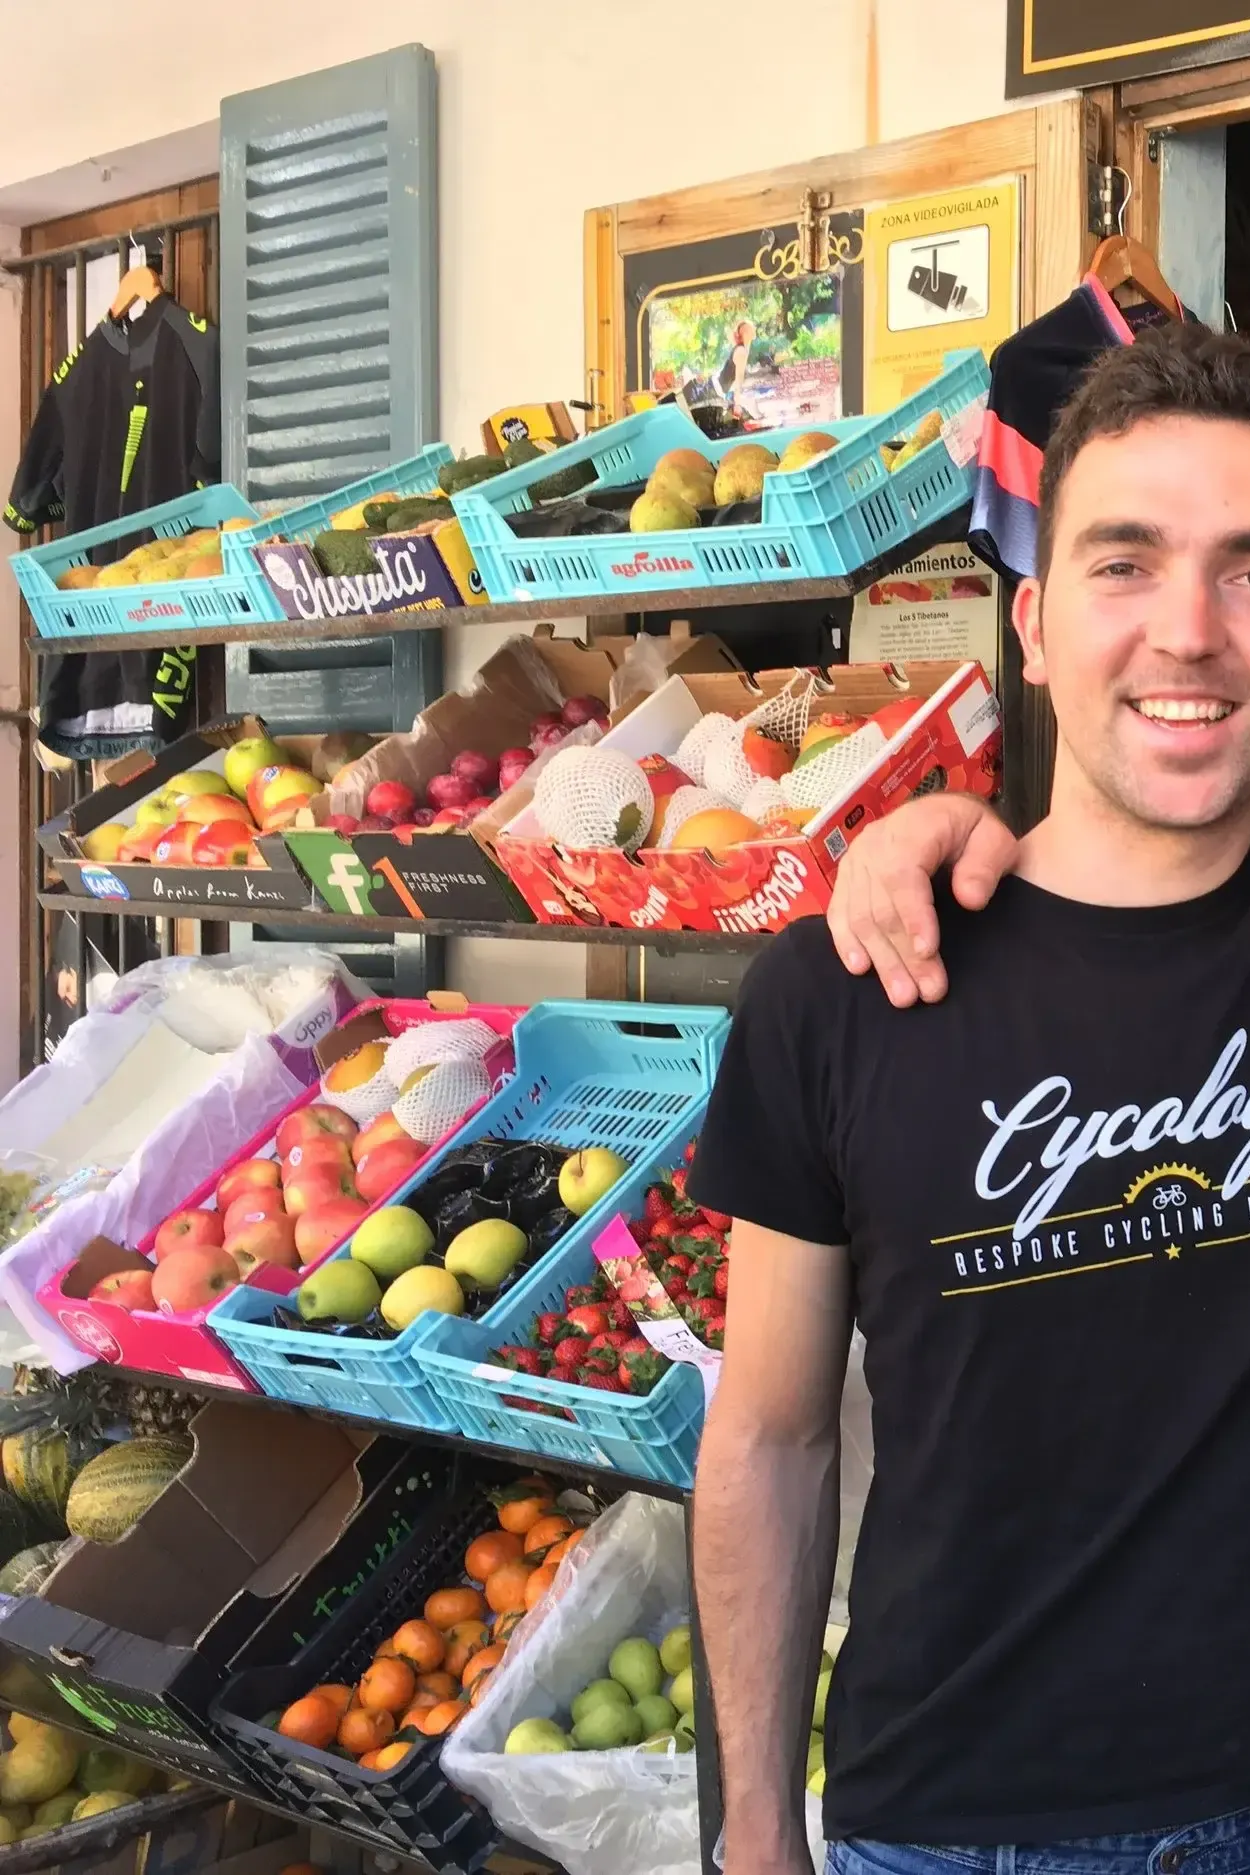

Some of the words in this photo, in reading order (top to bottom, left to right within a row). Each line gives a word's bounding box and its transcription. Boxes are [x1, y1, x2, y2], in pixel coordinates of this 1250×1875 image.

[881, 214, 911, 228] ZONA
[913, 196, 999, 222] VIDEOVIGILADA
[899, 614, 911, 622] Los
[917, 611, 949, 620] Tibetanos
[403, 871, 487, 885] FRESHNESS
[410, 882, 450, 894] FIRST
[954, 1230, 1080, 1277] BESPOKE
[1104, 1203, 1223, 1248] CYCLING
